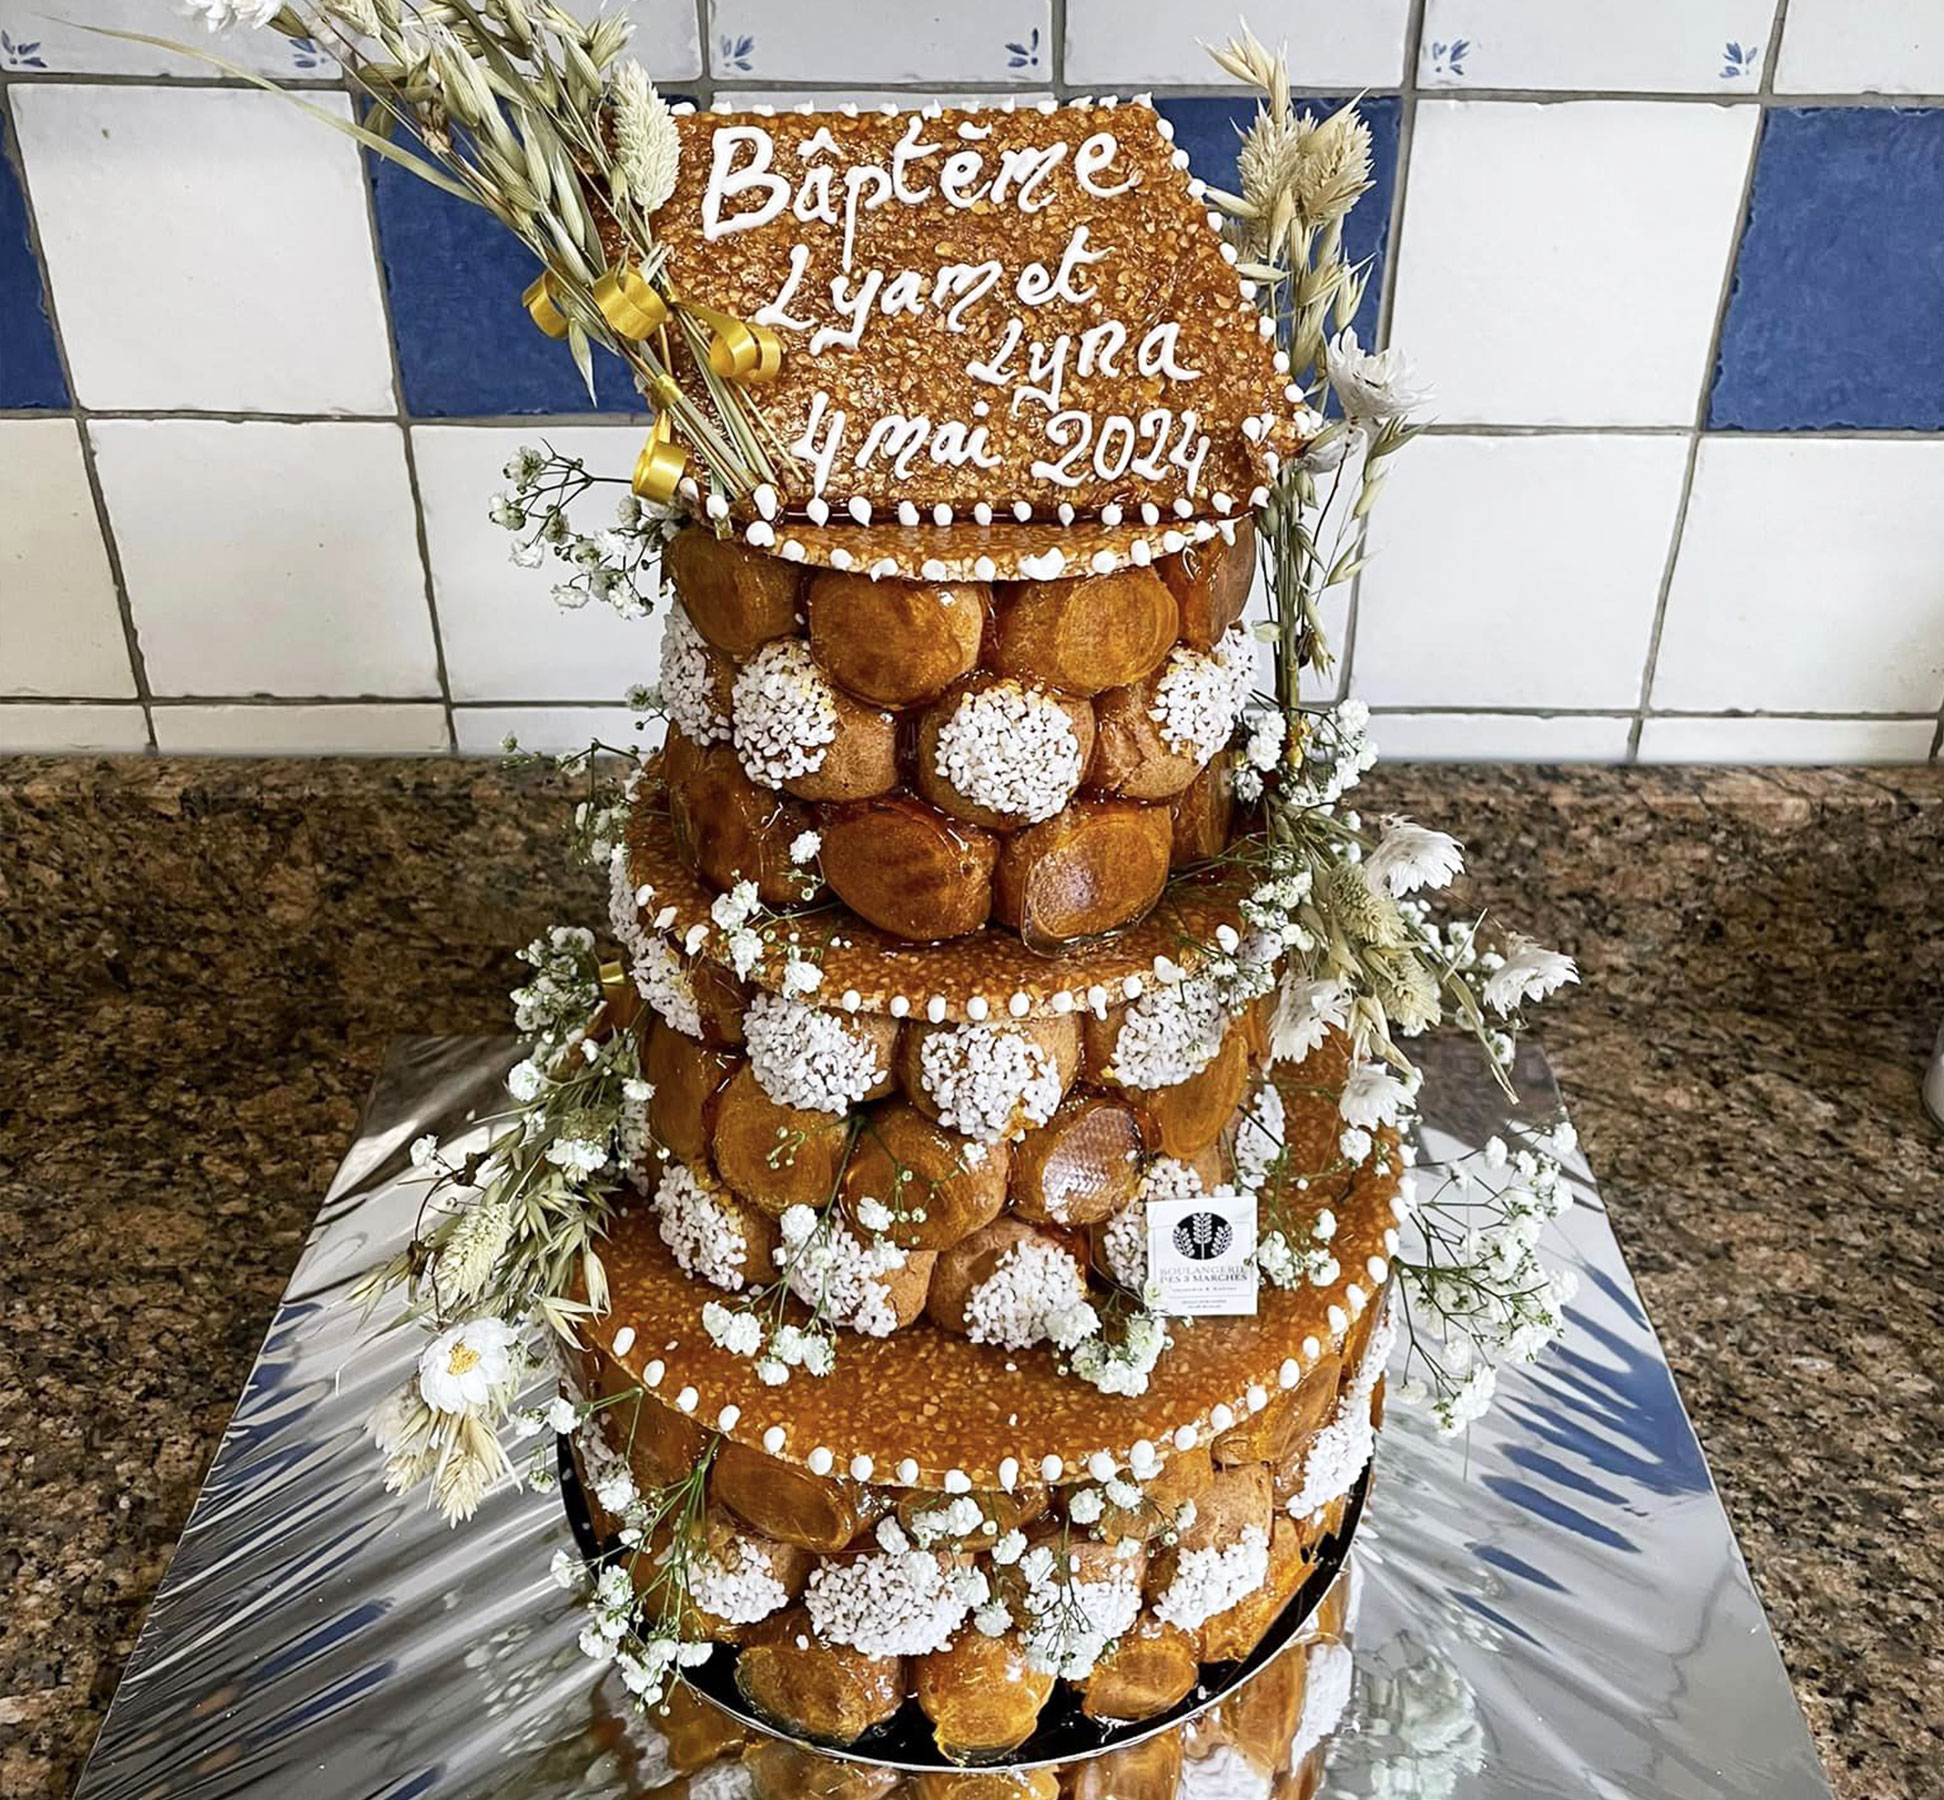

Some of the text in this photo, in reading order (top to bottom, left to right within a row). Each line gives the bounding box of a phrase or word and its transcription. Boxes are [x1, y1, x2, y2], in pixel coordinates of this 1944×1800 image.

[755, 225, 1116, 357] Lyam et
[791, 392, 1210, 498] 4 mai 2024
